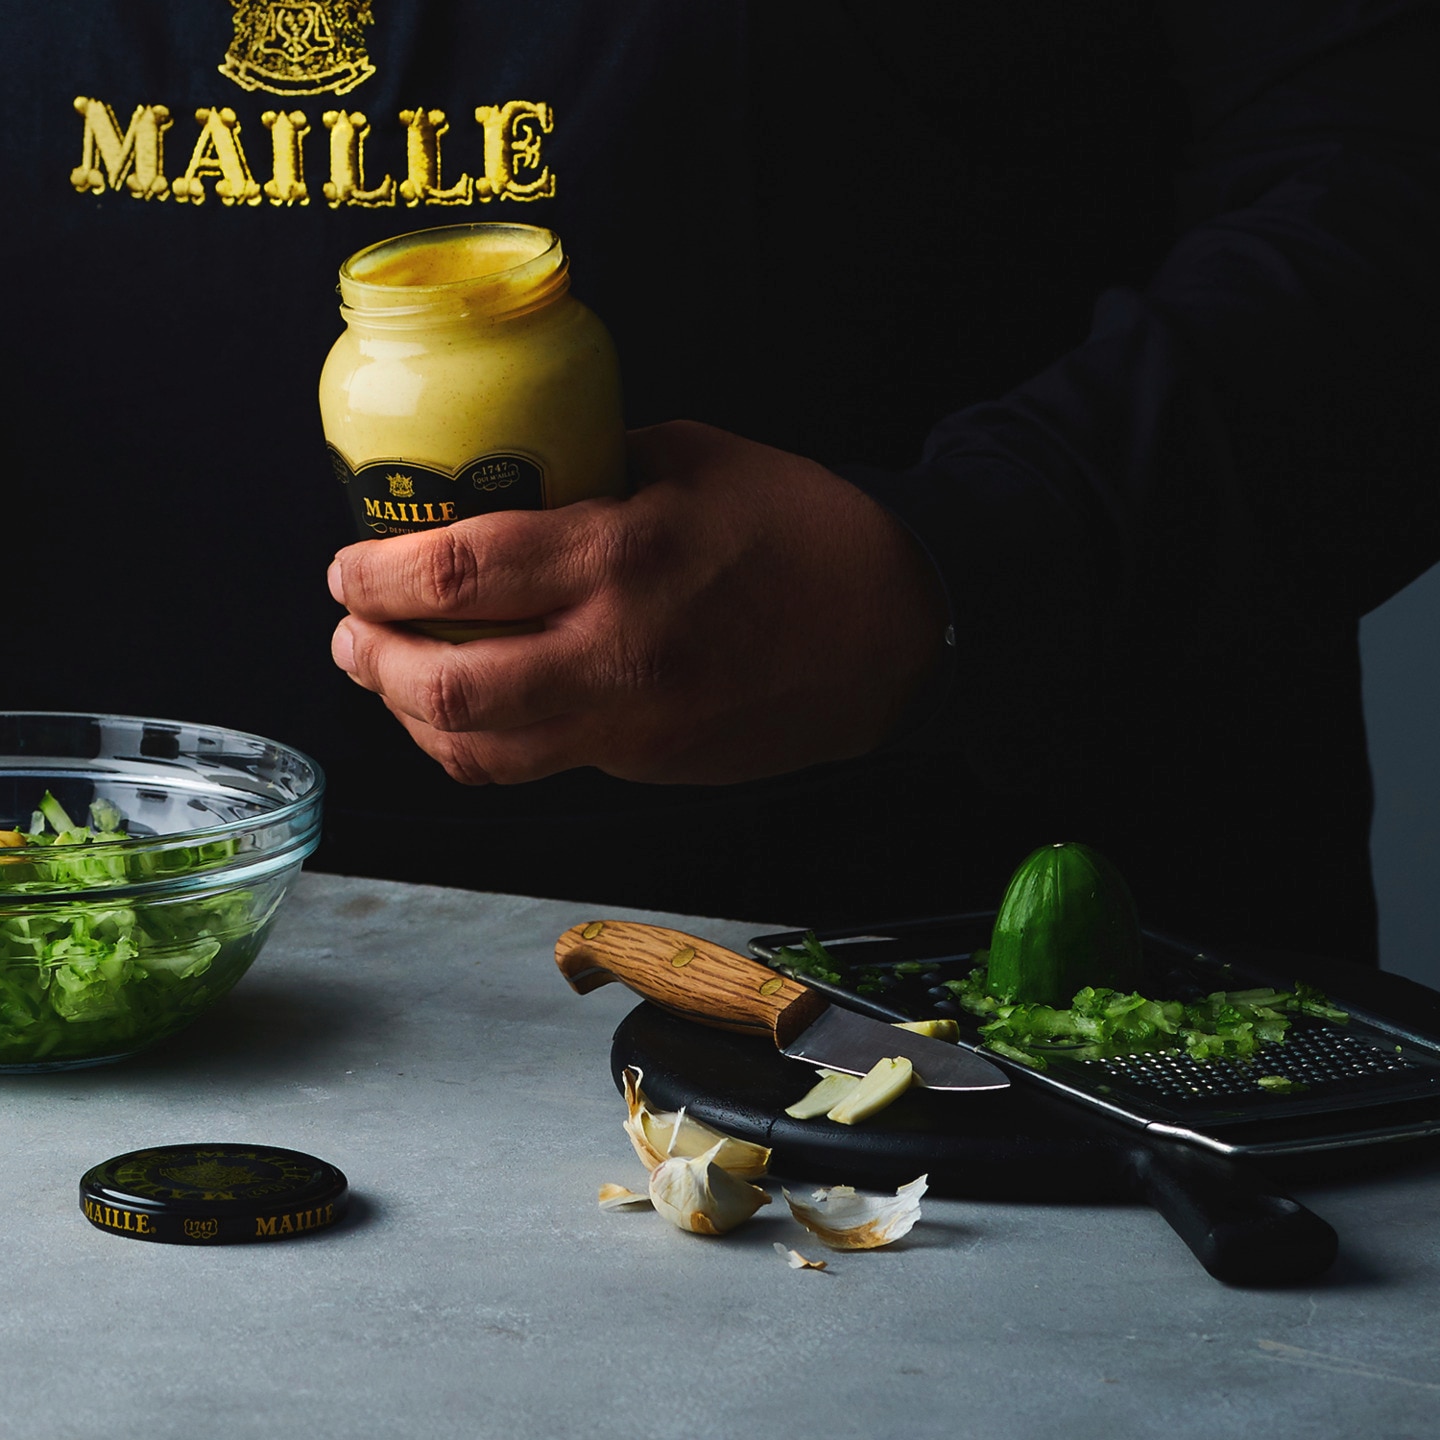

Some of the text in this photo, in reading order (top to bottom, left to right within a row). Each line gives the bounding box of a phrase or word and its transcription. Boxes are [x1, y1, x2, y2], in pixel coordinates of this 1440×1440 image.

[70, 95, 556, 209] MAILLE
[481, 461, 508, 475] 1747
[363, 496, 458, 523] MAILLE
[189, 1220, 213, 1232] 1747
[255, 1202, 335, 1237] MAILLE
